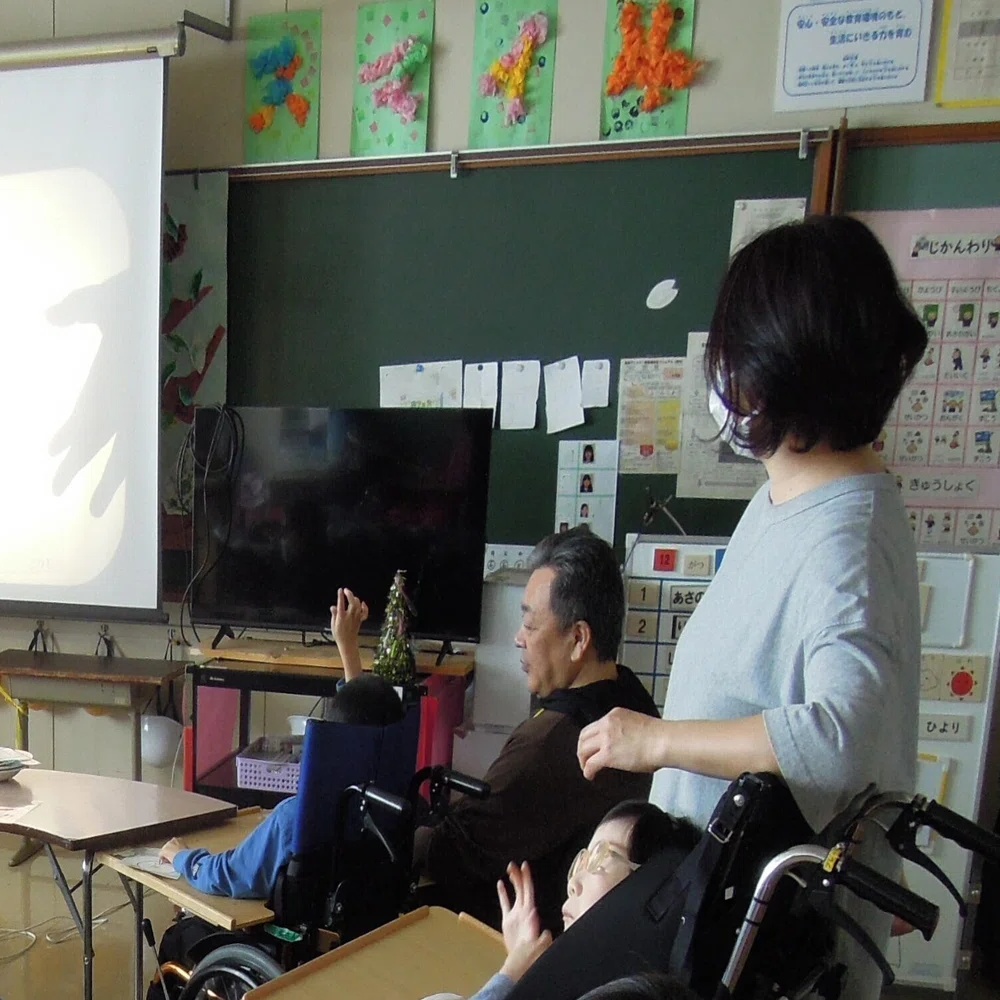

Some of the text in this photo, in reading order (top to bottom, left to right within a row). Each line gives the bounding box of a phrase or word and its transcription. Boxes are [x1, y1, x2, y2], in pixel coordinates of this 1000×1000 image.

[929, 239, 990, 254] じかんわり
[909, 479, 976, 491] きゅうしょく
[660, 554, 670, 565] 12
[640, 586, 647, 601] 1
[637, 618, 647, 634] 2
[926, 721, 960, 734] ひより
